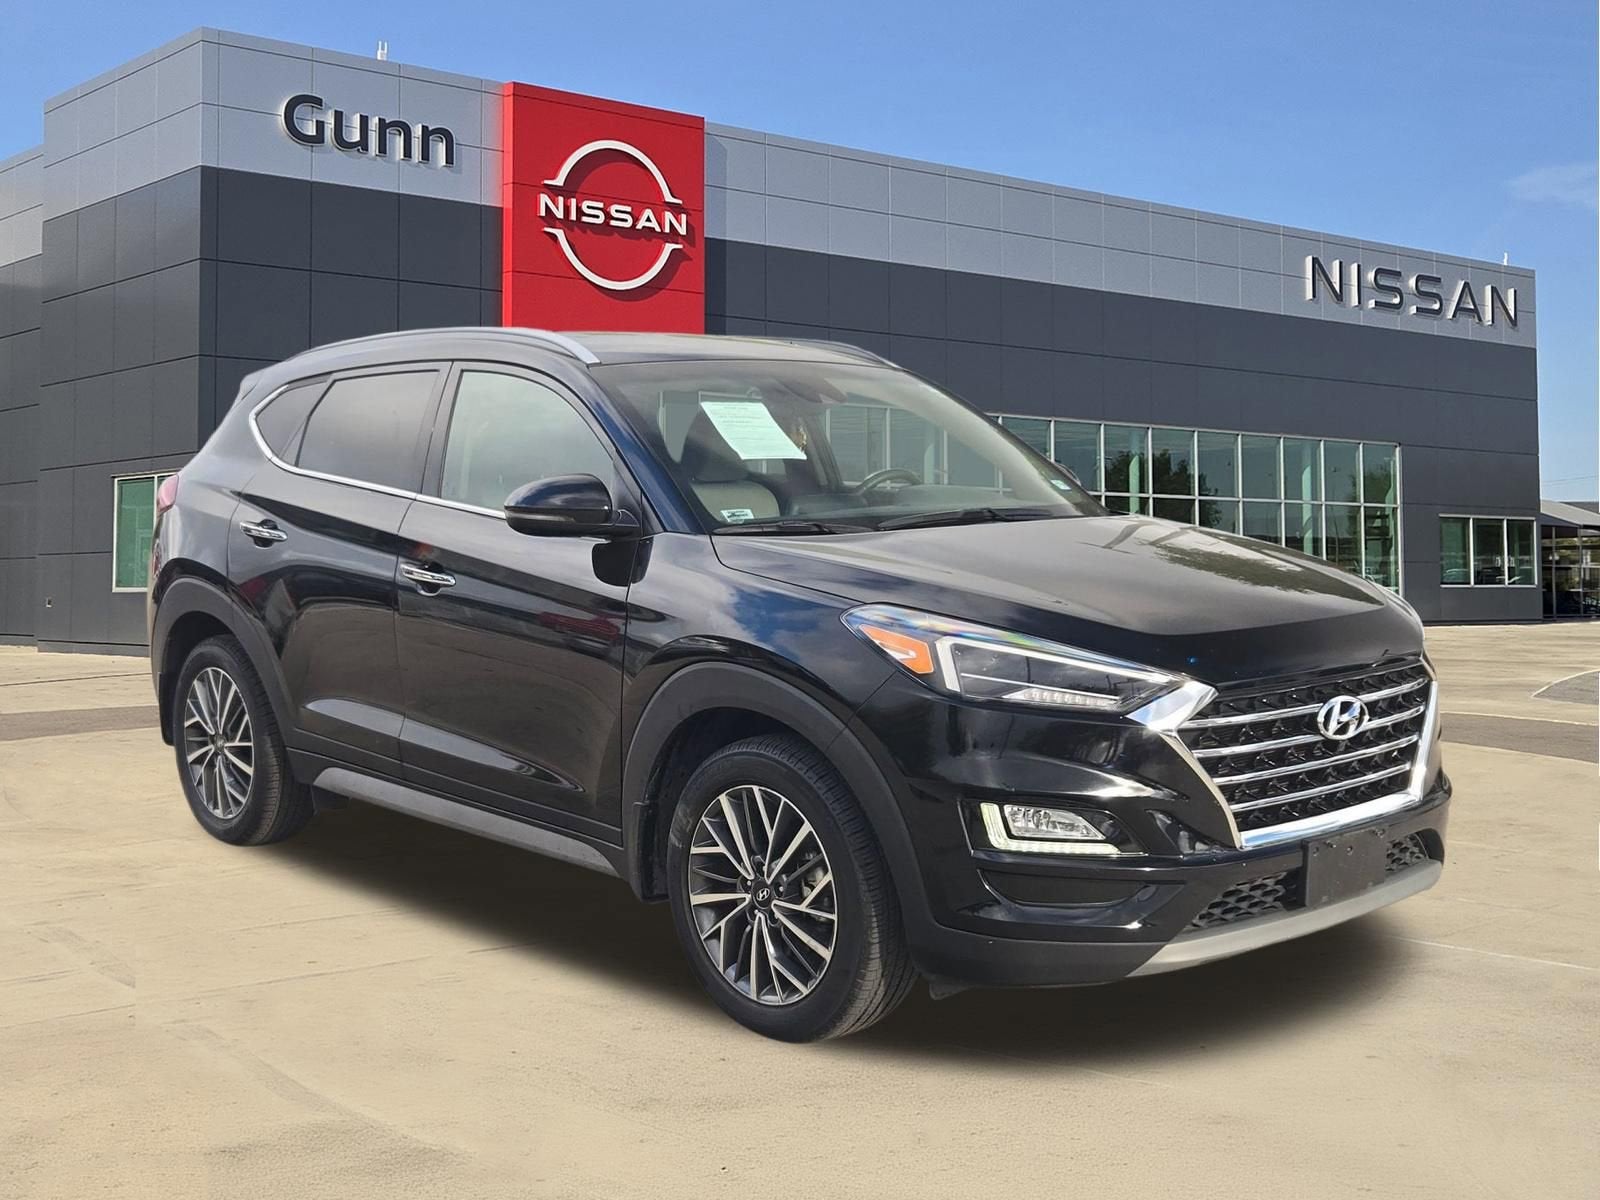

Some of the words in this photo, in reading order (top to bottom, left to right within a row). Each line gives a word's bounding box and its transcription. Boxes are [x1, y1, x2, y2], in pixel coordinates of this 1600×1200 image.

[282, 93, 455, 167] Gunn
[538, 193, 687, 236] NISSAN
[1305, 255, 1518, 328] NISSAN
